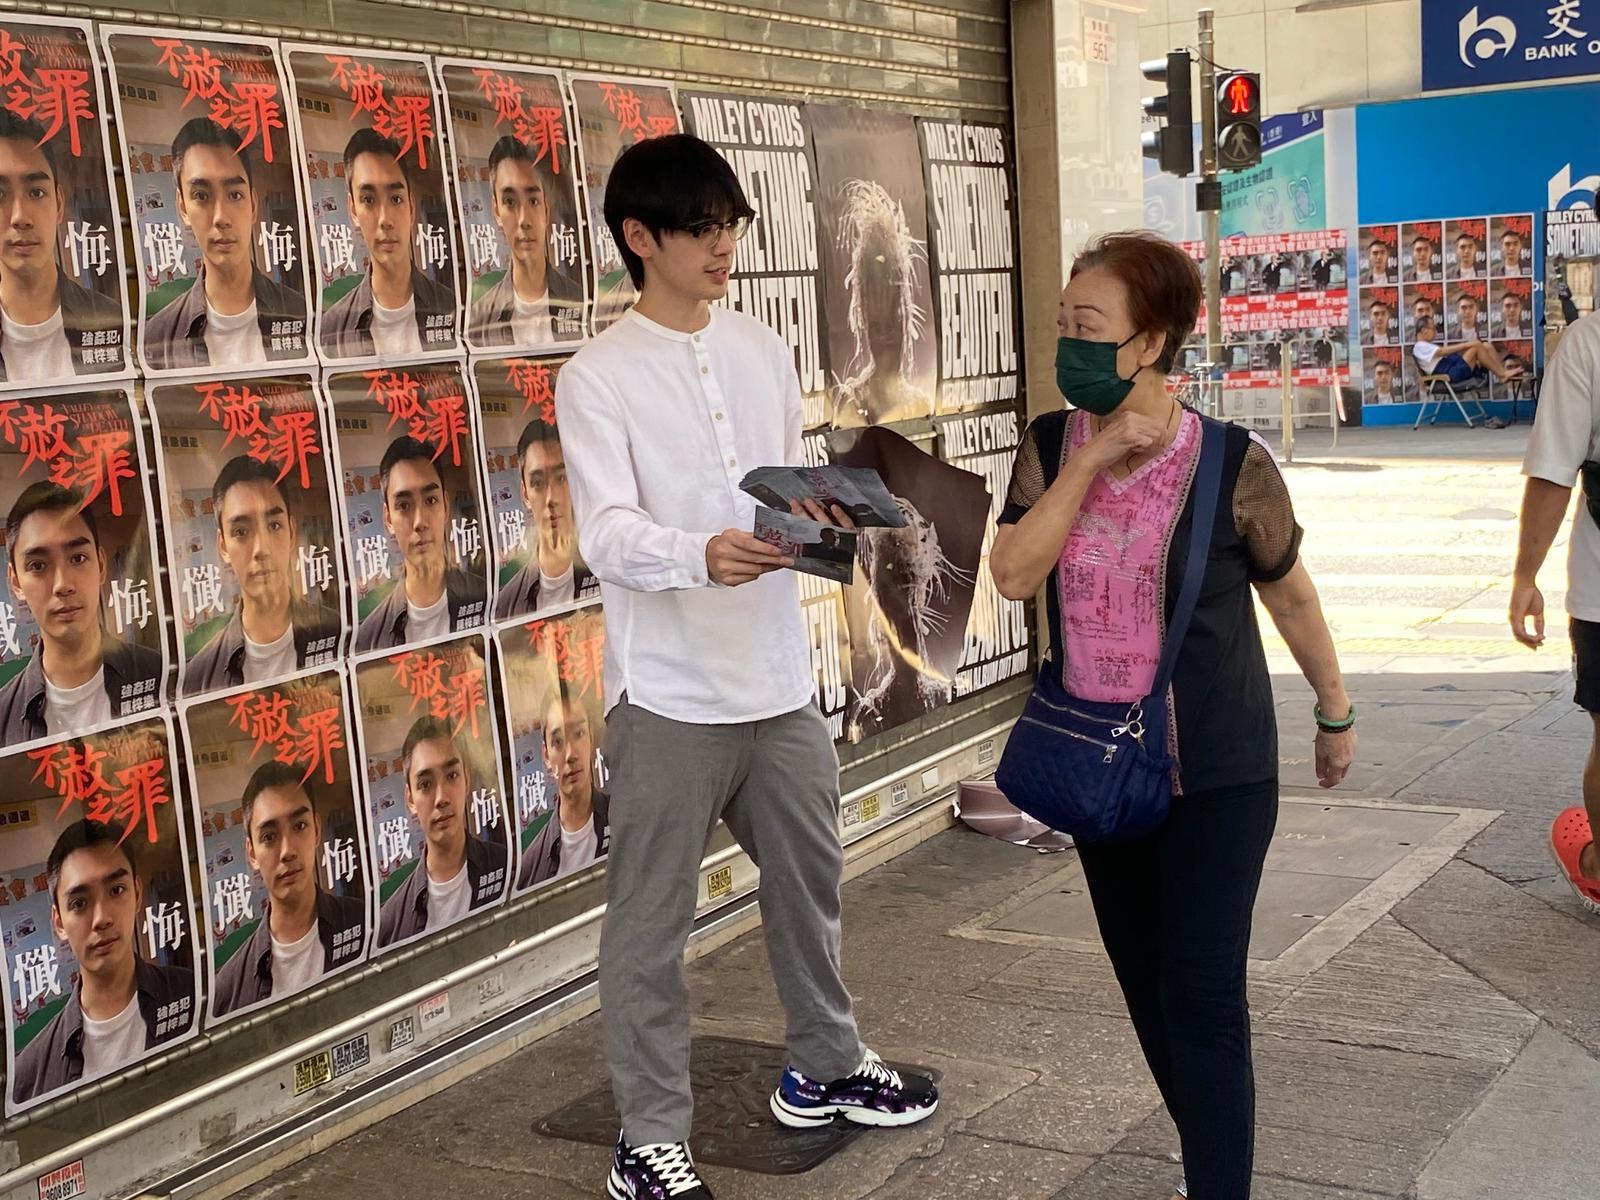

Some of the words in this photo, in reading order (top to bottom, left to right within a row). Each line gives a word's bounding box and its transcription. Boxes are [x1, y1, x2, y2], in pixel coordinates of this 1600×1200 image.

[1525, 43, 1577, 61] BANK
[151, 38, 284, 164] 不赦之罪
[325, 55, 434, 170] 不赦之罪
[472, 69, 566, 175] 不赦之罪
[691, 97, 750, 145] MILEY
[747, 102, 806, 148] CYRUS
[923, 121, 966, 161] MILEY
[963, 125, 1005, 163] CYRUS
[65, 221, 112, 277] 悔
[144, 222, 187, 276] 懺
[259, 222, 297, 273] 悔
[321, 223, 358, 274] 懺
[416, 223, 449, 270] 悔
[470, 223, 500, 269] 懺
[550, 223, 577, 267] 悔
[930, 164, 1014, 272] SOMETHING
[1547, 209, 1574, 225] MILEY
[1547, 222, 1600, 257] SOMETHIN
[940, 272, 1017, 379] BEAUTIFUL
[362, 369, 469, 467] 不赦之罪
[503, 358, 556, 426] 不赦之
[0, 400, 136, 517] 不赦之罪
[193, 382, 321, 490] 不赦之罪
[942, 417, 980, 459] MILEY
[980, 410, 1018, 452] CYRUS
[356, 535, 392, 586] 懺
[450, 517, 481, 565] 悔
[498, 509, 529, 553] 懺
[108, 578, 153, 634] 悔
[181, 564, 225, 620] 懺
[296, 544, 335, 596] 悔
[388, 651, 486, 740] 不赦之罪
[998, 655, 1012, 682] OUT
[225, 687, 344, 788] 不赦之罪
[26, 742, 169, 848] 不赦之罪
[377, 815, 413, 870] 懺
[470, 787, 500, 835] 悔
[519, 771, 548, 818] 懺
[213, 873, 255, 932] 懺
[322, 838, 357, 890] 悔
[14, 944, 62, 1010] 懺
[143, 901, 186, 959] 悔
